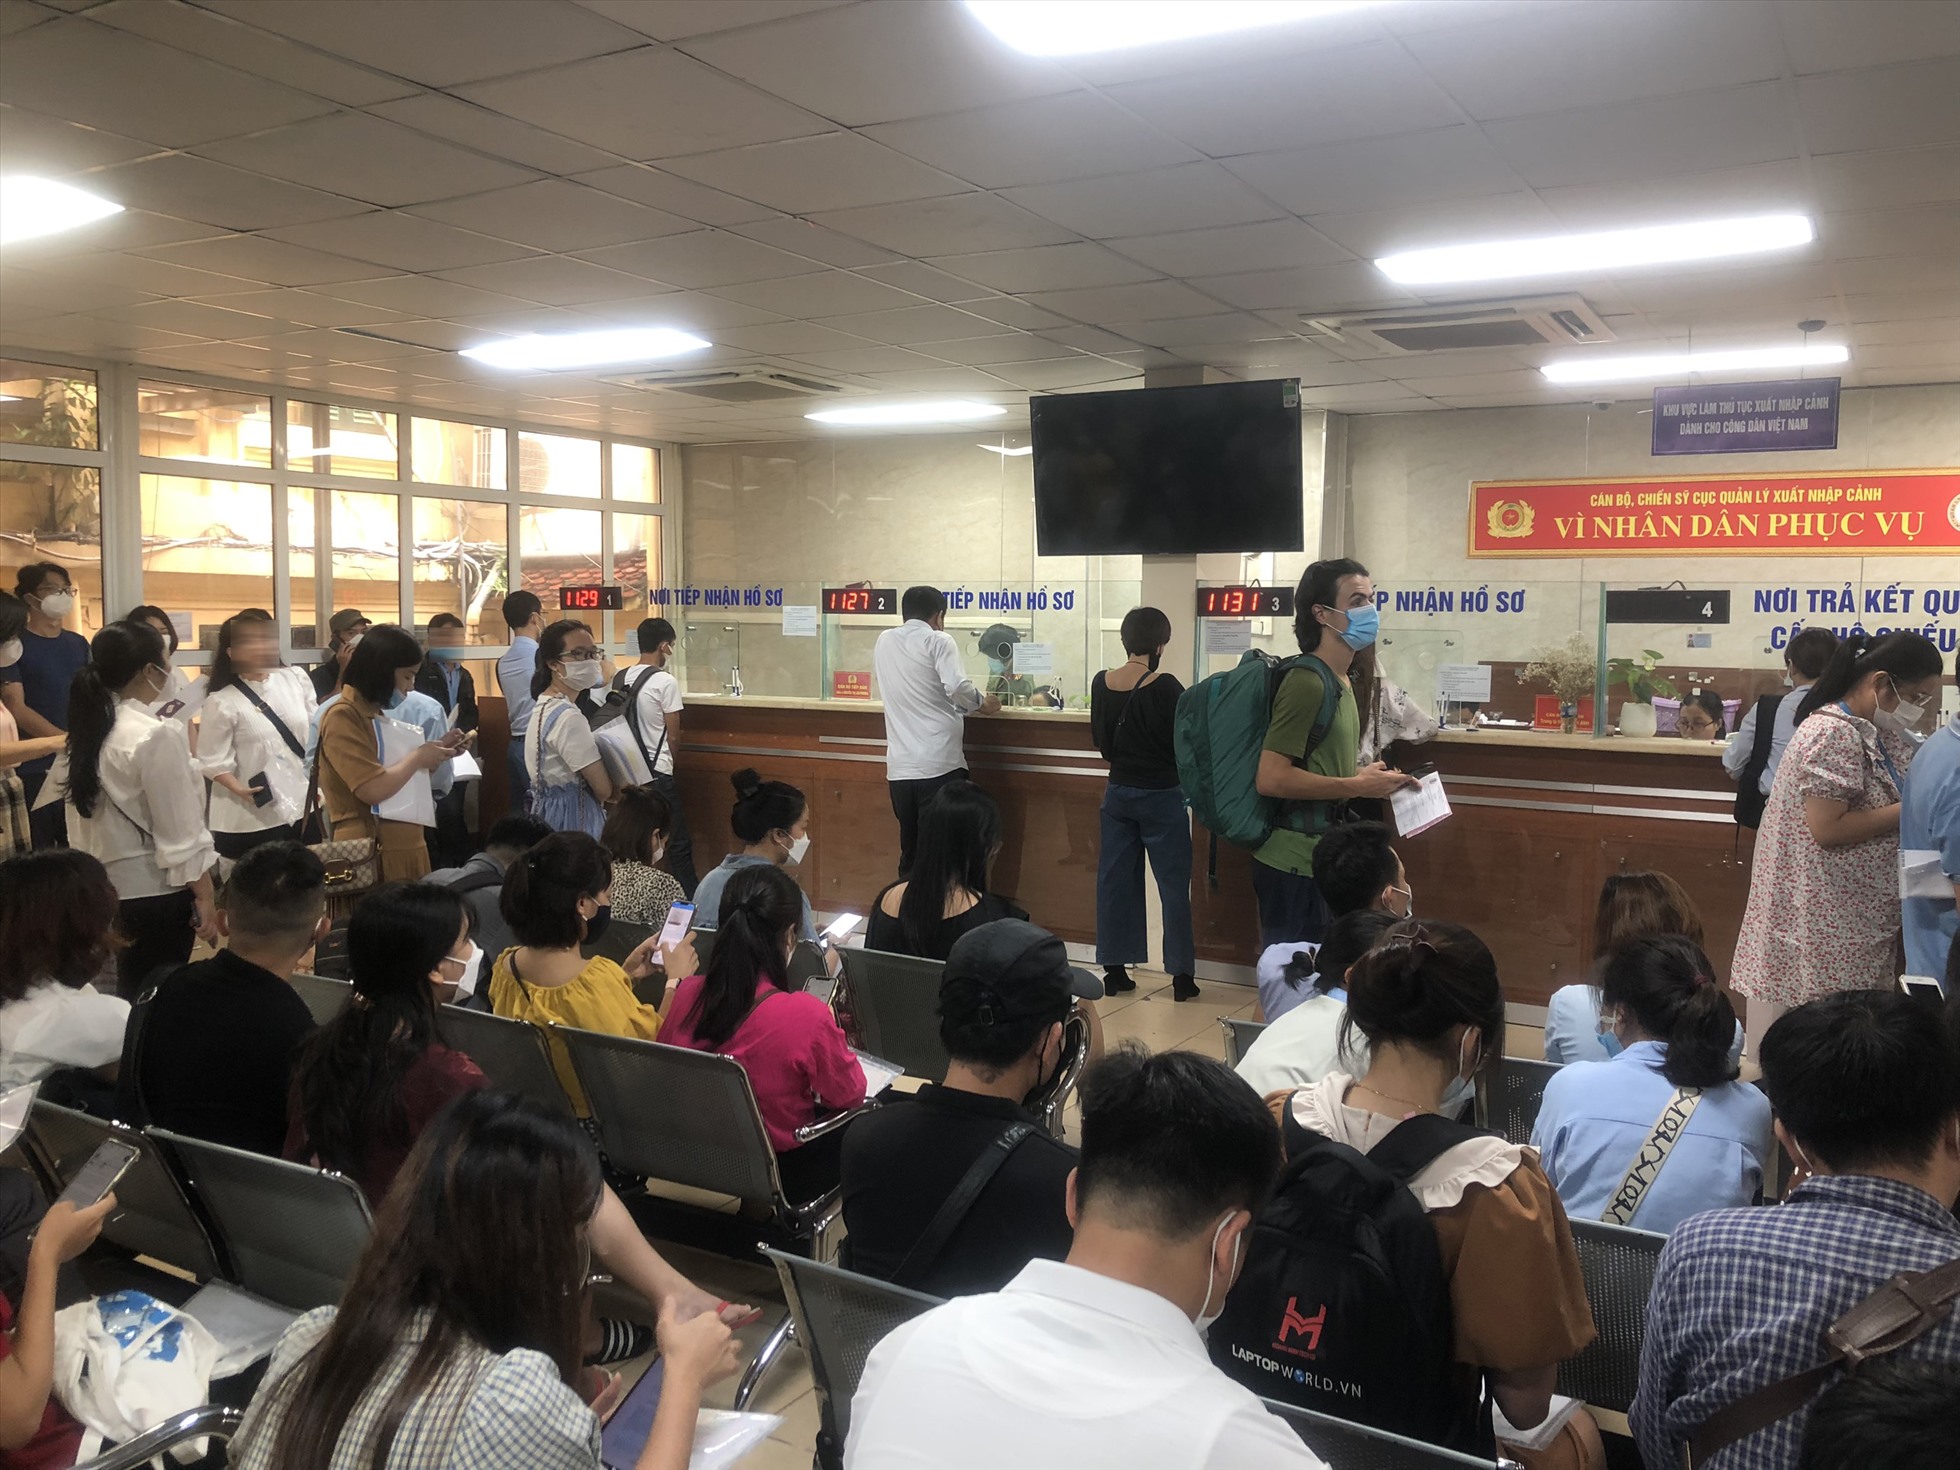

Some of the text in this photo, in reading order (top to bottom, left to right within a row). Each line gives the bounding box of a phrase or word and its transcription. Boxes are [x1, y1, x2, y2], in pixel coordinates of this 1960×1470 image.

[1663, 392, 1829, 418] KHU VỰC LÀM THỦ TỤC XUẤT NHẬP CẢNH
[1680, 416, 1809, 435] DÀNH CHO CÔNG DÂN VIỆT NAM
[1590, 484, 1882, 509] CÁN BỘ, CHIẾN SỸ CỤC QUẢN LÝ XUẤT NHẬP CẢNH
[1553, 511, 1586, 539] VÌ
[1592, 510, 1683, 539] NHÂN
[1689, 509, 1760, 538] DÂN
[1767, 511, 1865, 542] PHỤC
[1873, 511, 1925, 541] VỤ
[566, 590, 612, 607] 1129 1
[649, 584, 783, 609] NƠI TIẾP NHẬN HỒ SƠ
[831, 592, 885, 610] 1127 2
[979, 588, 1022, 613] NHẬN
[1026, 585, 1047, 610] HỒ
[1052, 590, 1074, 610] SƠ
[1208, 592, 1280, 612] 1131 3
[1396, 586, 1454, 616] NHẬN
[1460, 584, 1489, 613] HỒ
[1496, 589, 1526, 613] SƠ
[1753, 587, 1797, 613] NƠI
[1806, 581, 1855, 613] TRẢ
[1864, 582, 1914, 613] KẾT
[1701, 601, 1713, 618] 4
